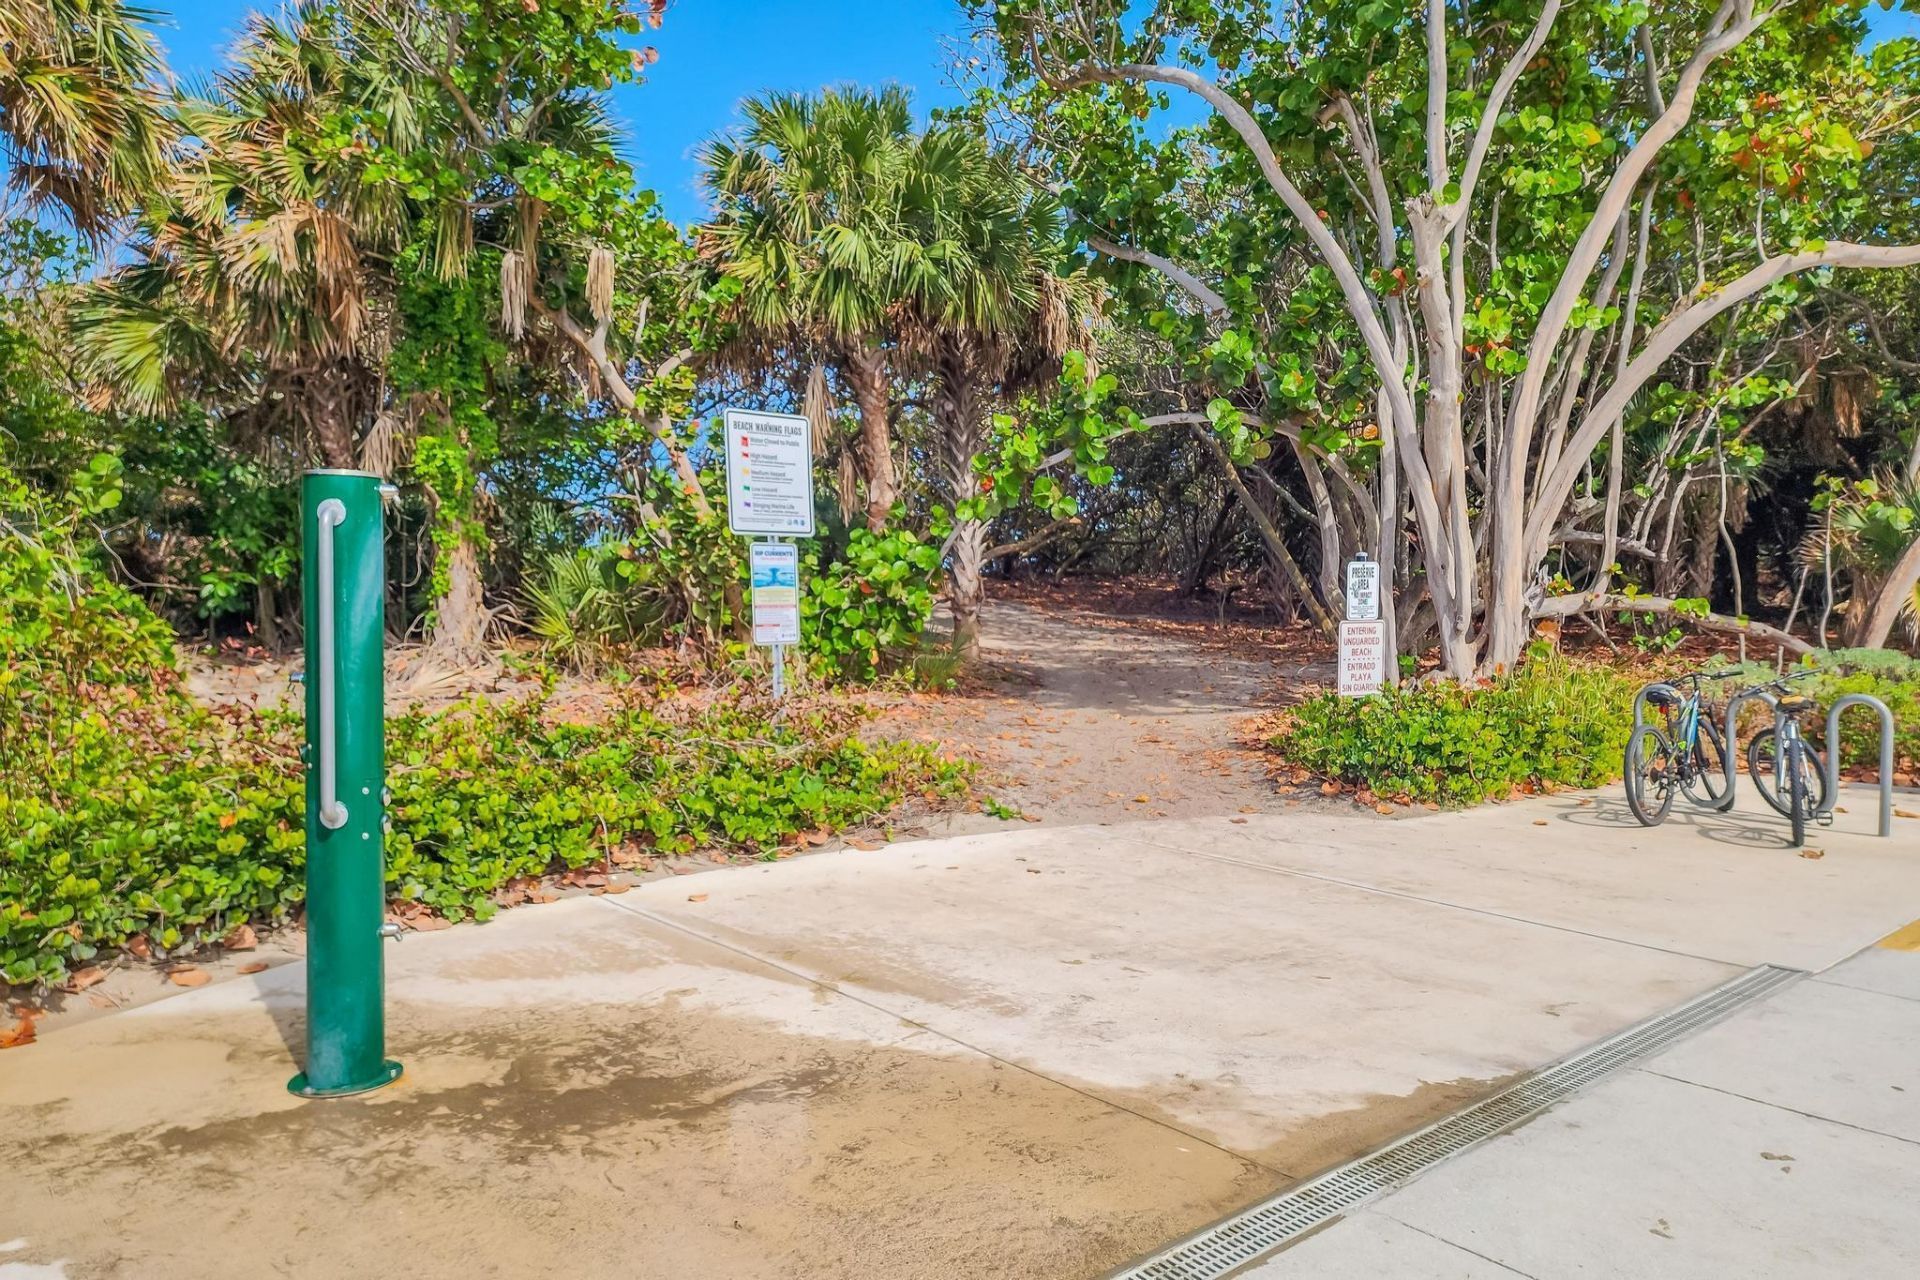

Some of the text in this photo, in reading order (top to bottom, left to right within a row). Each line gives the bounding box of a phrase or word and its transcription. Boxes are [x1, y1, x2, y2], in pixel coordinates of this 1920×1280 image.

[733, 421, 802, 436] BEACH WARNING FLAGS
[1352, 567, 1375, 578] PRESERVE
[1357, 579, 1369, 590] AREA
[1347, 626, 1376, 635] ENTERING
[1344, 637, 1380, 646] UNGUARDED
[1352, 648, 1372, 656] BEACH
[1348, 662, 1376, 670] ENTRADO
[1351, 673, 1372, 682] PLAYA
[1342, 684, 1352, 692] SIN
